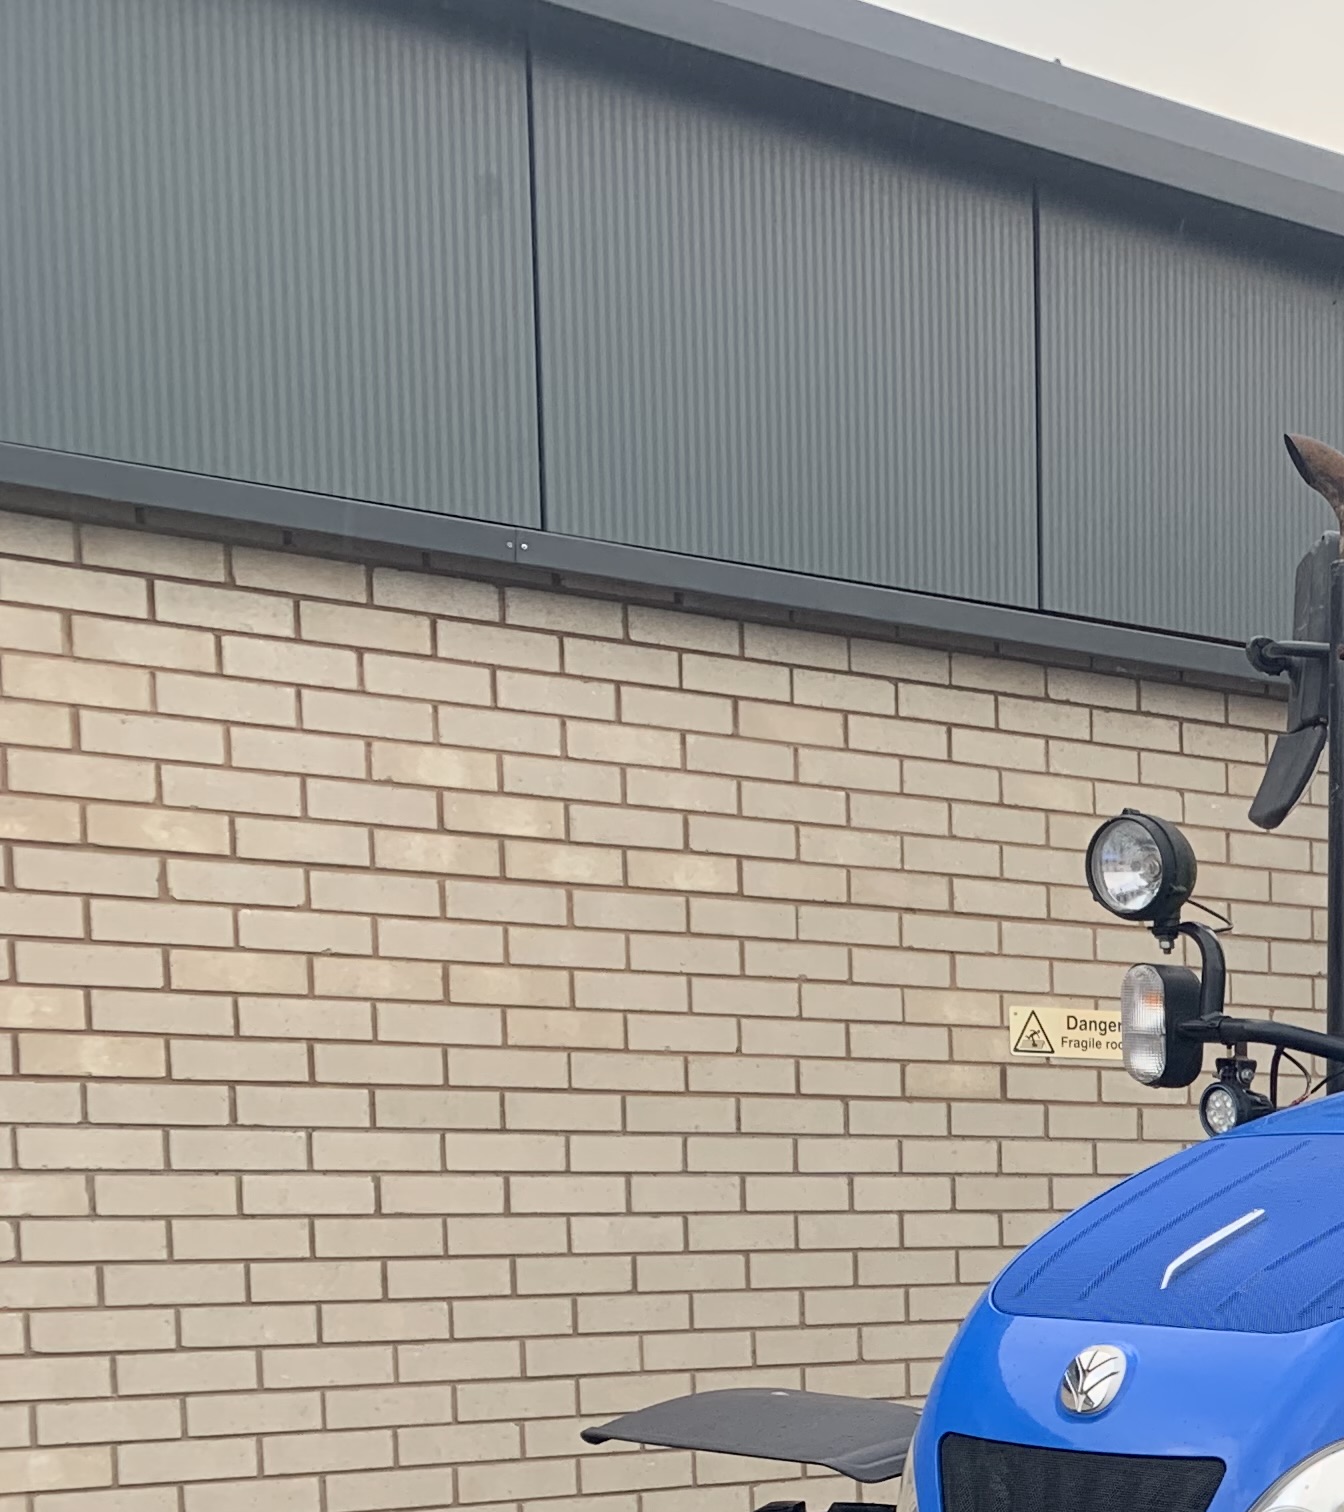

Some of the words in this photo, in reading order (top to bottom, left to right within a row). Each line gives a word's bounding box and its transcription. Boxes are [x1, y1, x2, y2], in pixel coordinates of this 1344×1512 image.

[1066, 1015, 1122, 1036] Danger
[1061, 1036, 1103, 1052] Fragile
[1105, 1041, 1123, 1050] roo
